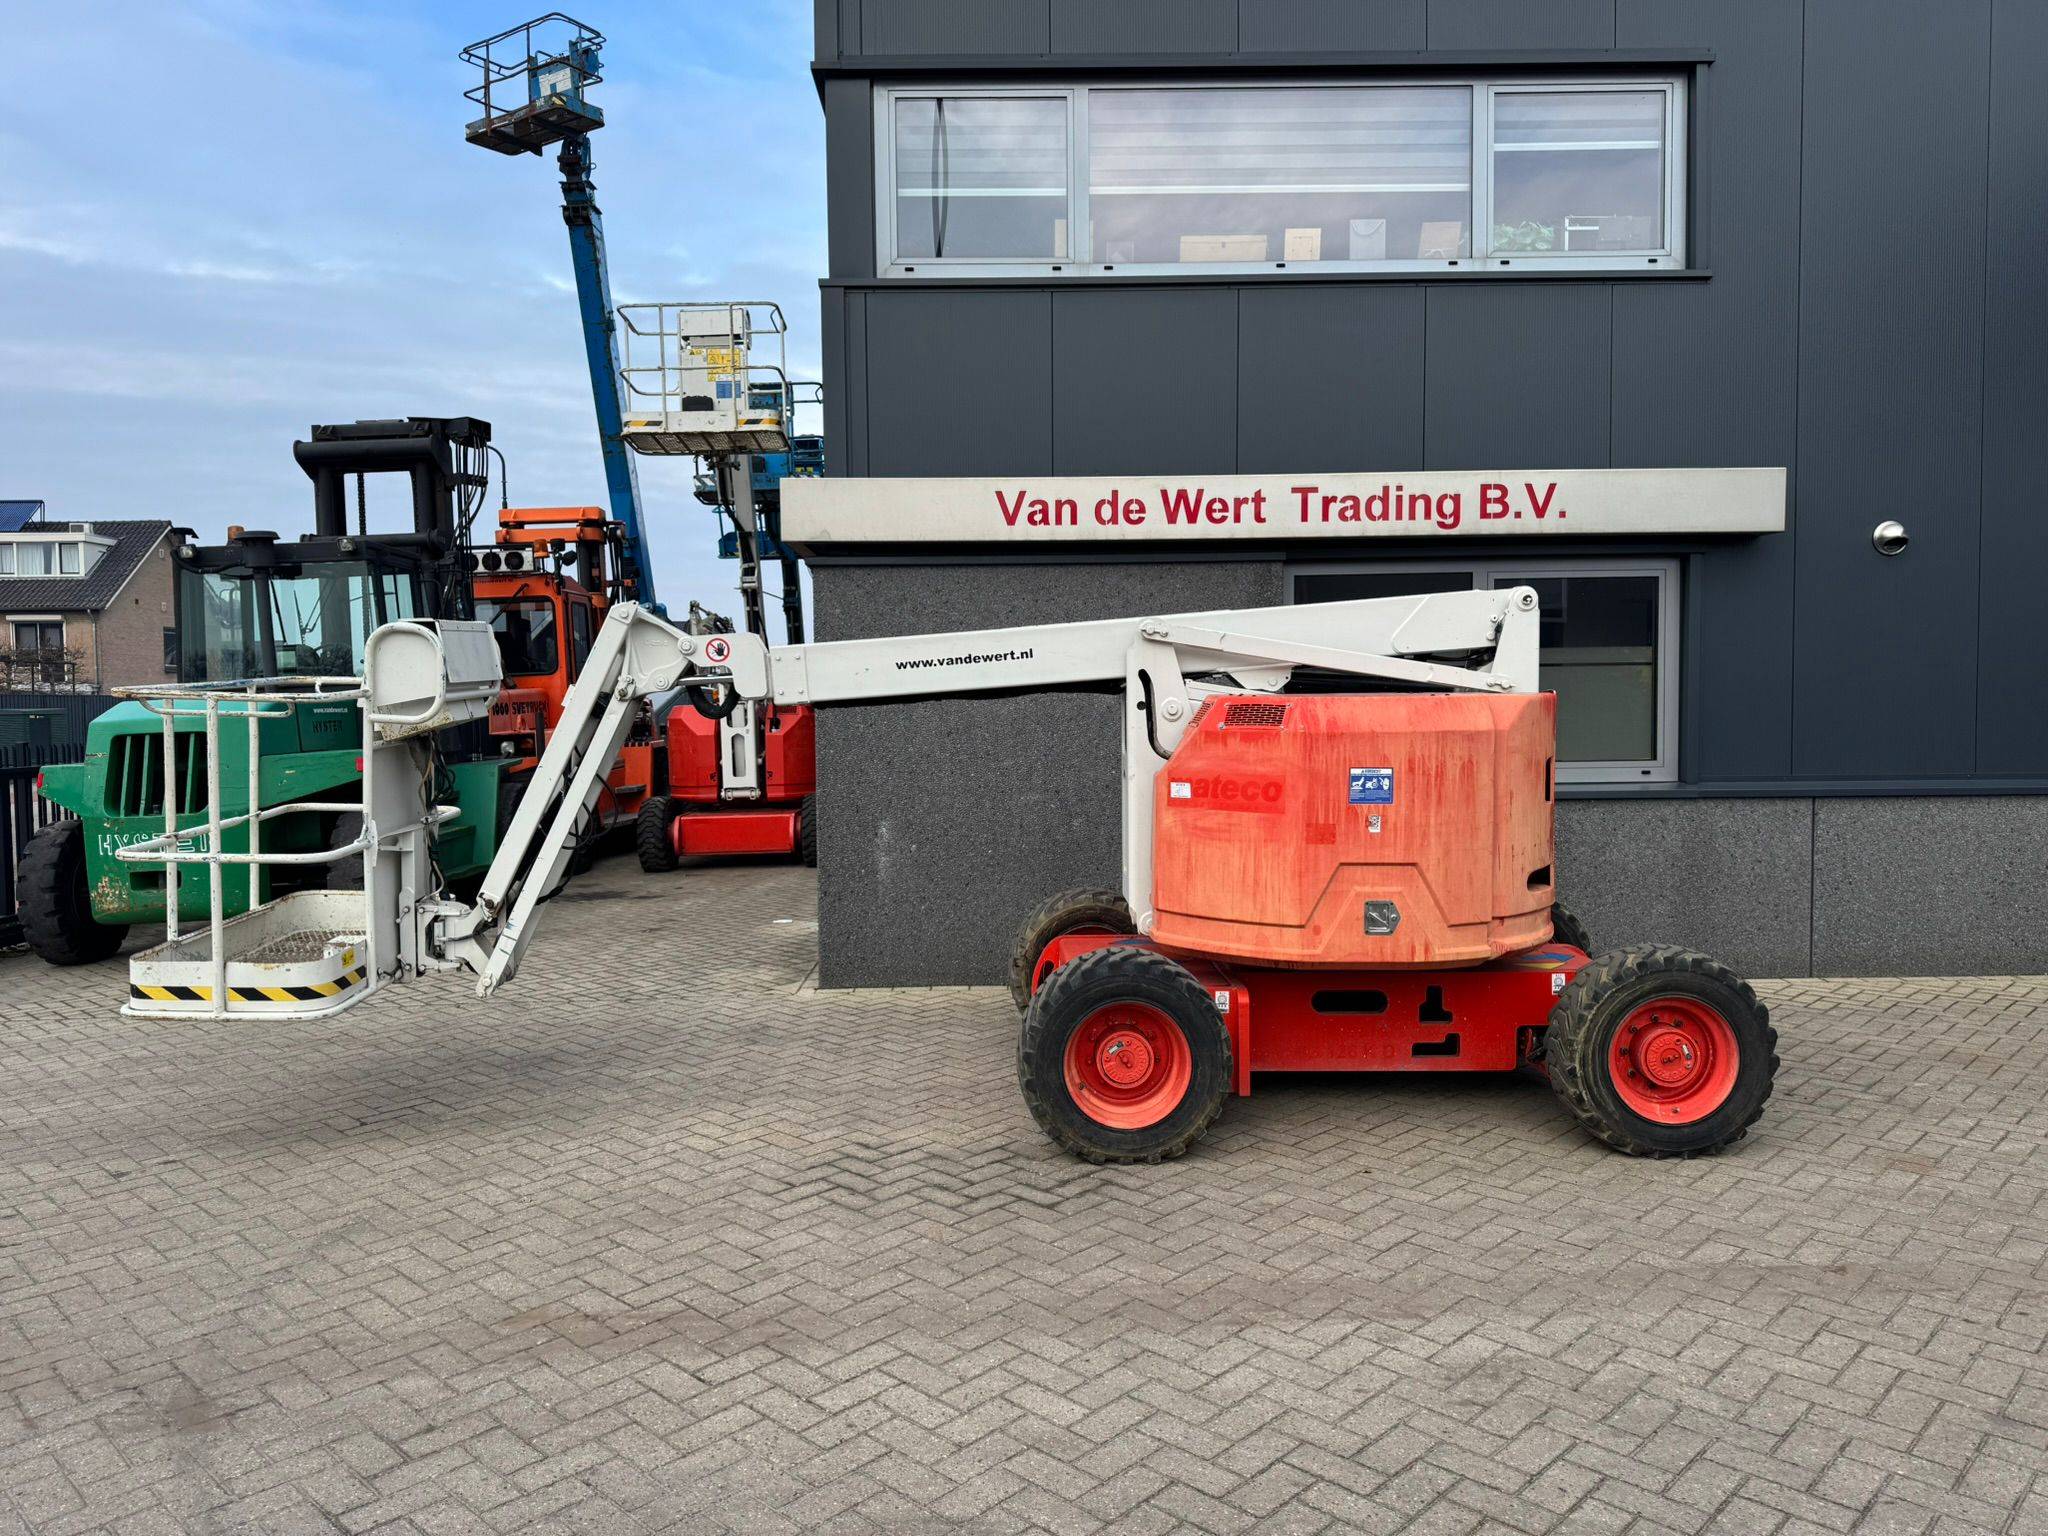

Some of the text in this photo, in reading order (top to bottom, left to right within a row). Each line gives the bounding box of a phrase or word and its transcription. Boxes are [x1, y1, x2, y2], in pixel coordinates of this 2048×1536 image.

[995, 483, 1566, 530] Van de Wert Trading B.V.
[895, 648, 1034, 670] www.vandewert.nl
[1169, 774, 1282, 803] ateco
